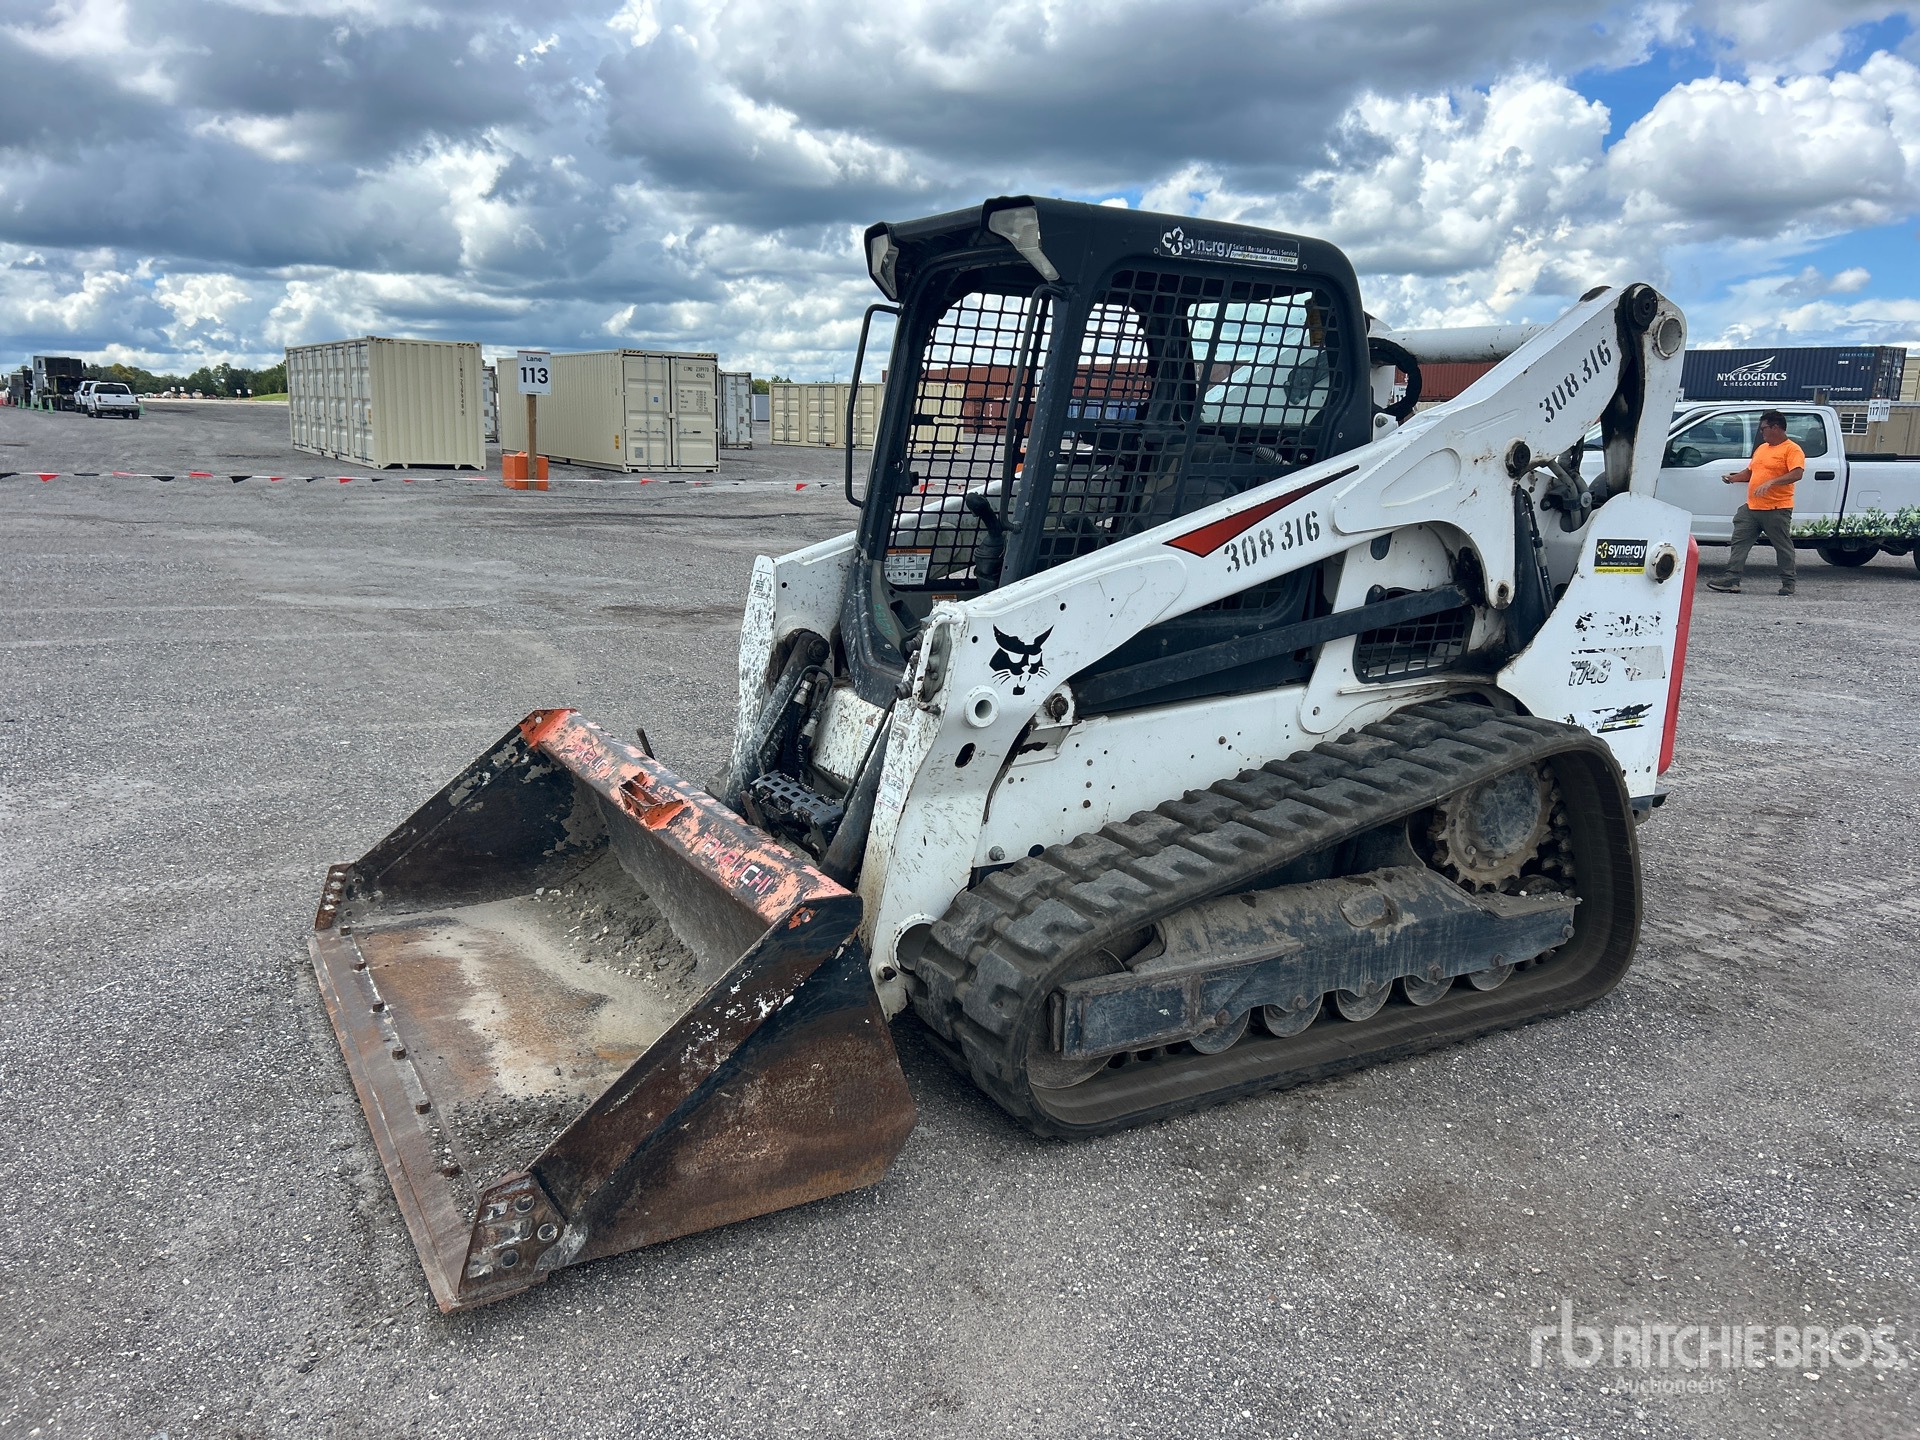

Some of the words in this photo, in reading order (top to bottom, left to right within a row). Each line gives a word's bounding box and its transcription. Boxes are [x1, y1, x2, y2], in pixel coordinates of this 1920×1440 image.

[1183, 238, 1232, 258] synergy
[520, 366, 549, 384] 113
[1539, 373, 1580, 423] 308
[1582, 339, 1612, 383] 316
[1716, 373, 1737, 381] NYK
[1738, 372, 1787, 381] LOGISTICS
[1869, 406, 1880, 416] 117
[1881, 406, 1889, 416] 117
[1224, 528, 1275, 573] 308
[1279, 510, 1320, 551] 316
[1608, 544, 1647, 559] synergy
